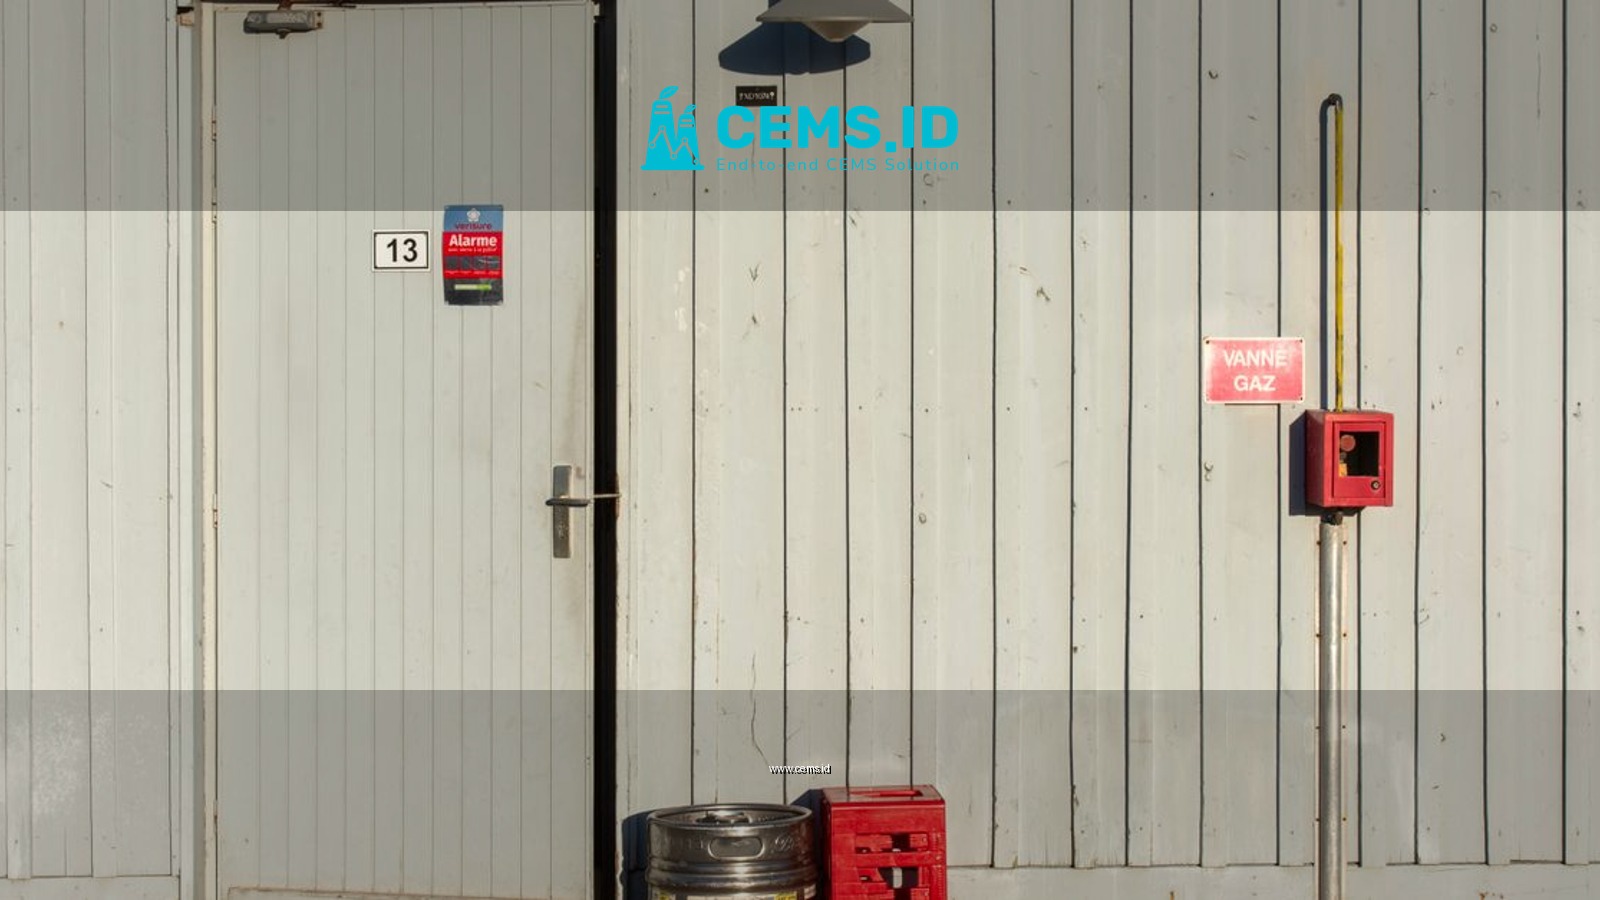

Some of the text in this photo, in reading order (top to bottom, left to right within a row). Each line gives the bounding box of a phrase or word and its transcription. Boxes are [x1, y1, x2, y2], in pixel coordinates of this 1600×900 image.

[449, 233, 498, 247] Alarme
[386, 238, 418, 263] 13
[1223, 349, 1288, 368] VANNE
[1233, 375, 1277, 392] GAZ
